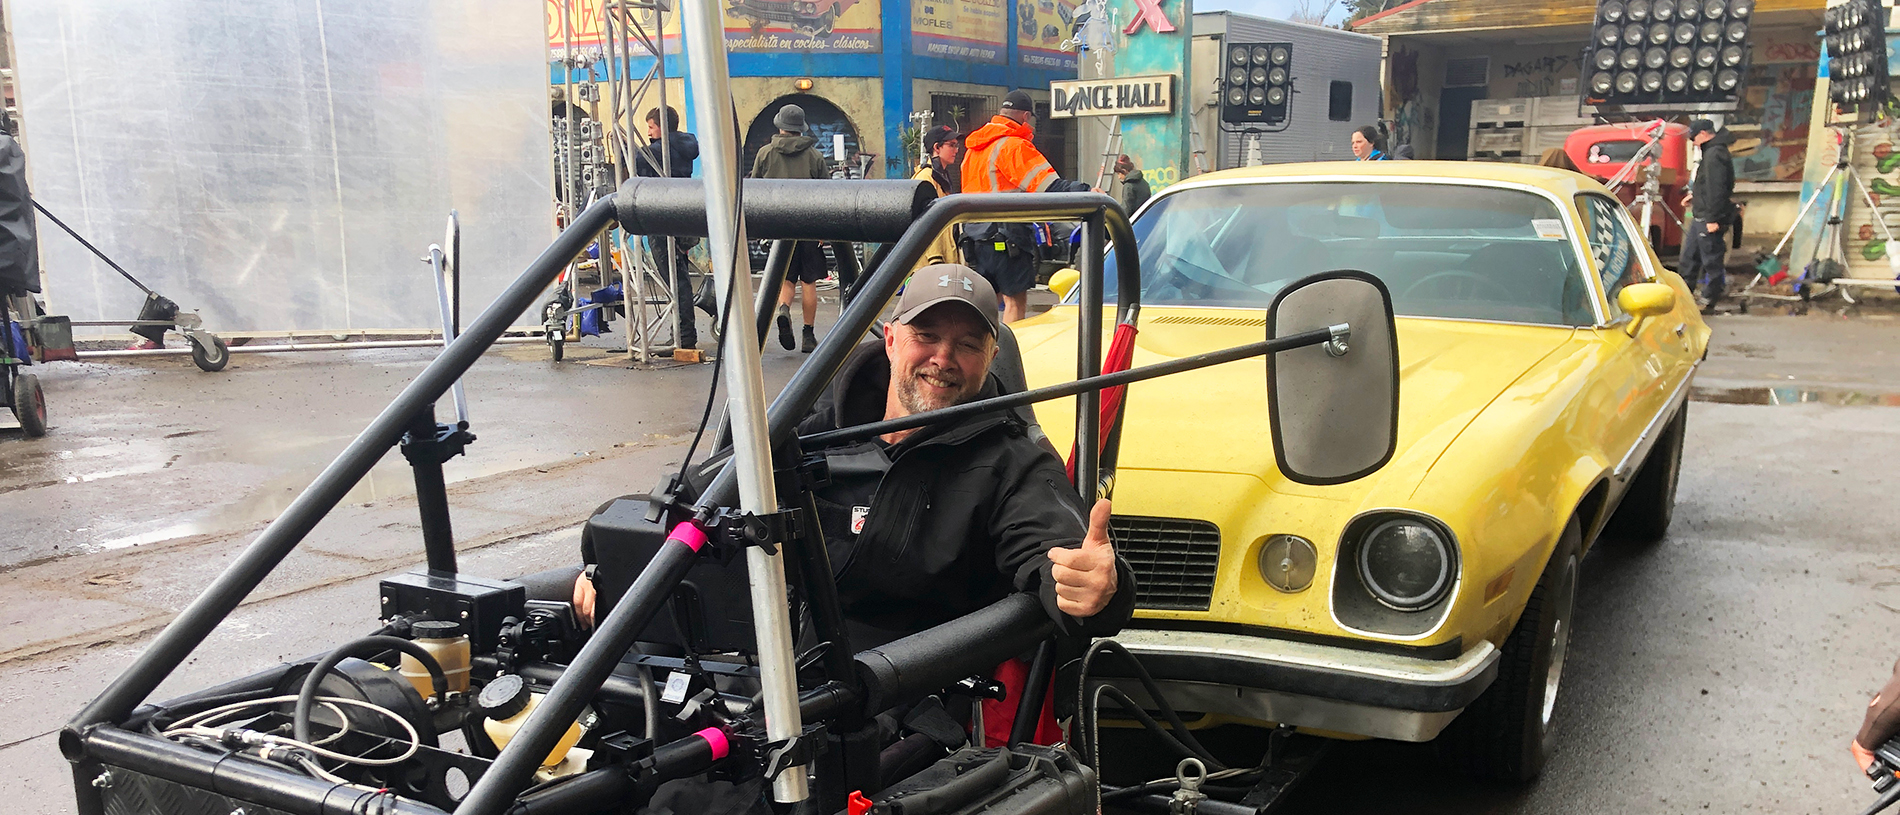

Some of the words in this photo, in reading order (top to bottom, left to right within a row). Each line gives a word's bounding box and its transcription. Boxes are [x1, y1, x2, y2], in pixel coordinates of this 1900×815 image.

[913, 17, 953, 30] MOFLES
[725, 34, 778, 52] especialista
[779, 39, 791, 49] en
[793, 35, 830, 49] coches
[833, 35, 874, 49] clásicos
[1054, 86, 1113, 116] DANCE
[1116, 82, 1166, 109] HALL
